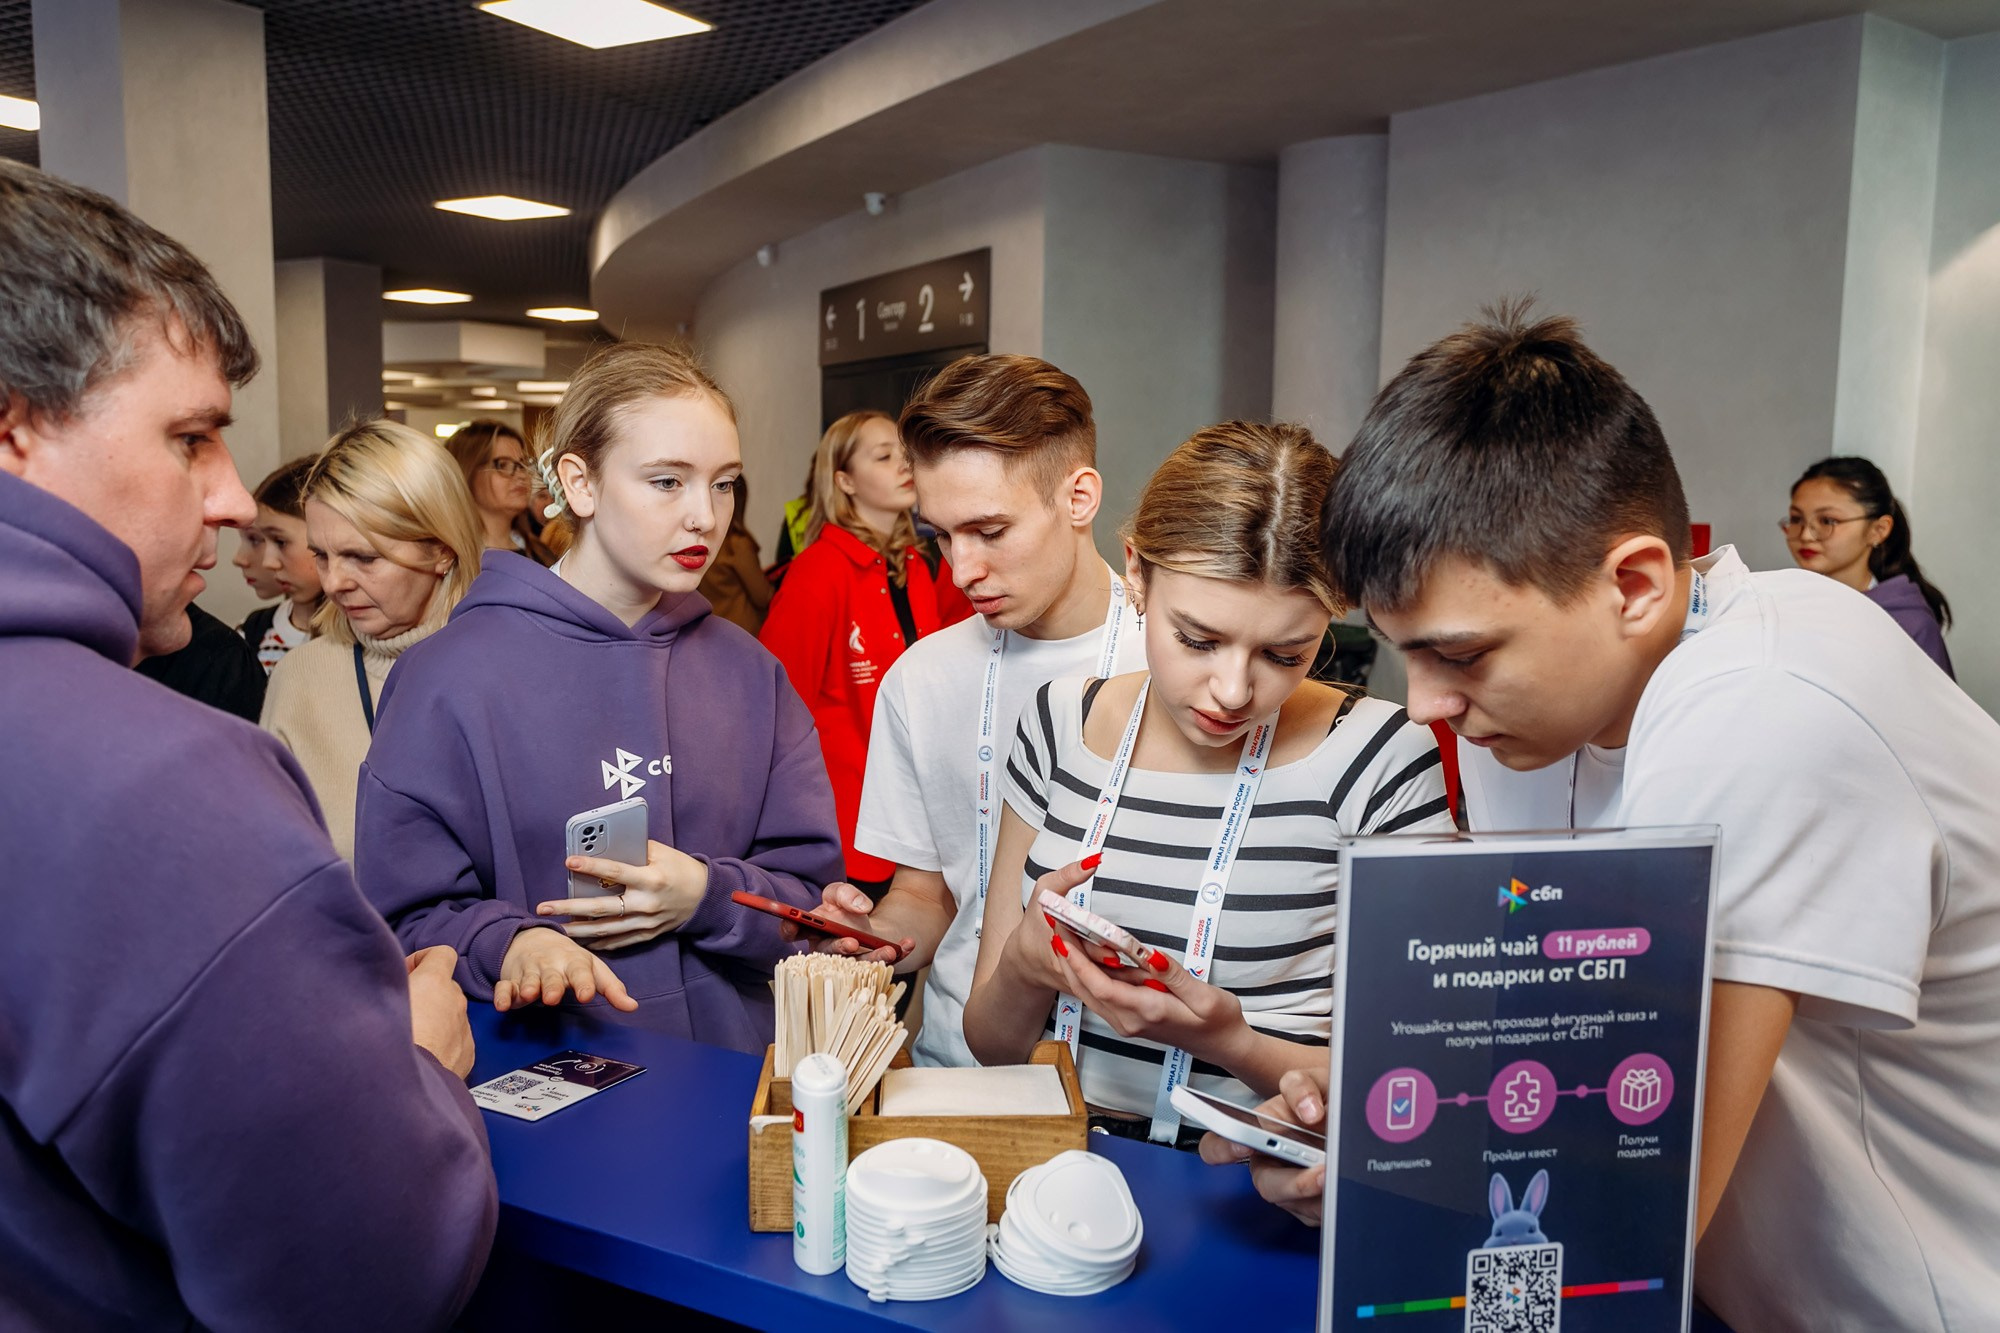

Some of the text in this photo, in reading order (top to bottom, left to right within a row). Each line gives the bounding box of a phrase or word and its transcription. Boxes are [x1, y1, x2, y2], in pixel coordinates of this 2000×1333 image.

[856, 298, 866, 341] 1
[918, 284, 934, 333] 2
[1692, 589, 1700, 614] ФИНАЛ
[1110, 626, 1119, 654] ГРАН-ПРИ
[1249, 725, 1264, 758] 2024/2025
[1255, 724, 1271, 759] КРАСНОЯРСК
[648, 755, 673, 776] сб
[1112, 759, 1126, 787] РОССИИ
[1093, 814, 1108, 846] 2024/2025
[1213, 783, 1246, 871] ФИНАЛ ГРАН-ПРИ РОССИИ
[1530, 885, 1563, 902] сбп
[1193, 919, 1205, 957] 2024/2025
[1200, 917, 1212, 958] КРАСНОЯРСК
[1407, 933, 1638, 965] Горячий чай 11 рублей
[1433, 959, 1626, 991] и подарки от СБП
[1391, 1019, 1454, 1036] Угощайся
[1493, 1016, 1549, 1031] проходи
[1551, 1010, 1615, 1028] фигурный
[1617, 1011, 1646, 1023] квиз
[1649, 1011, 1658, 1021] и
[1445, 1025, 1604, 1049] получи подарки от СБП!
[1167, 1063, 1178, 1093] ФИНАЛ
[1617, 1148, 1661, 1159] подарок
[1619, 1134, 1659, 1147] Получи
[1367, 1159, 1432, 1172] Подпишись
[1483, 1148, 1558, 1164] Пройди квест
